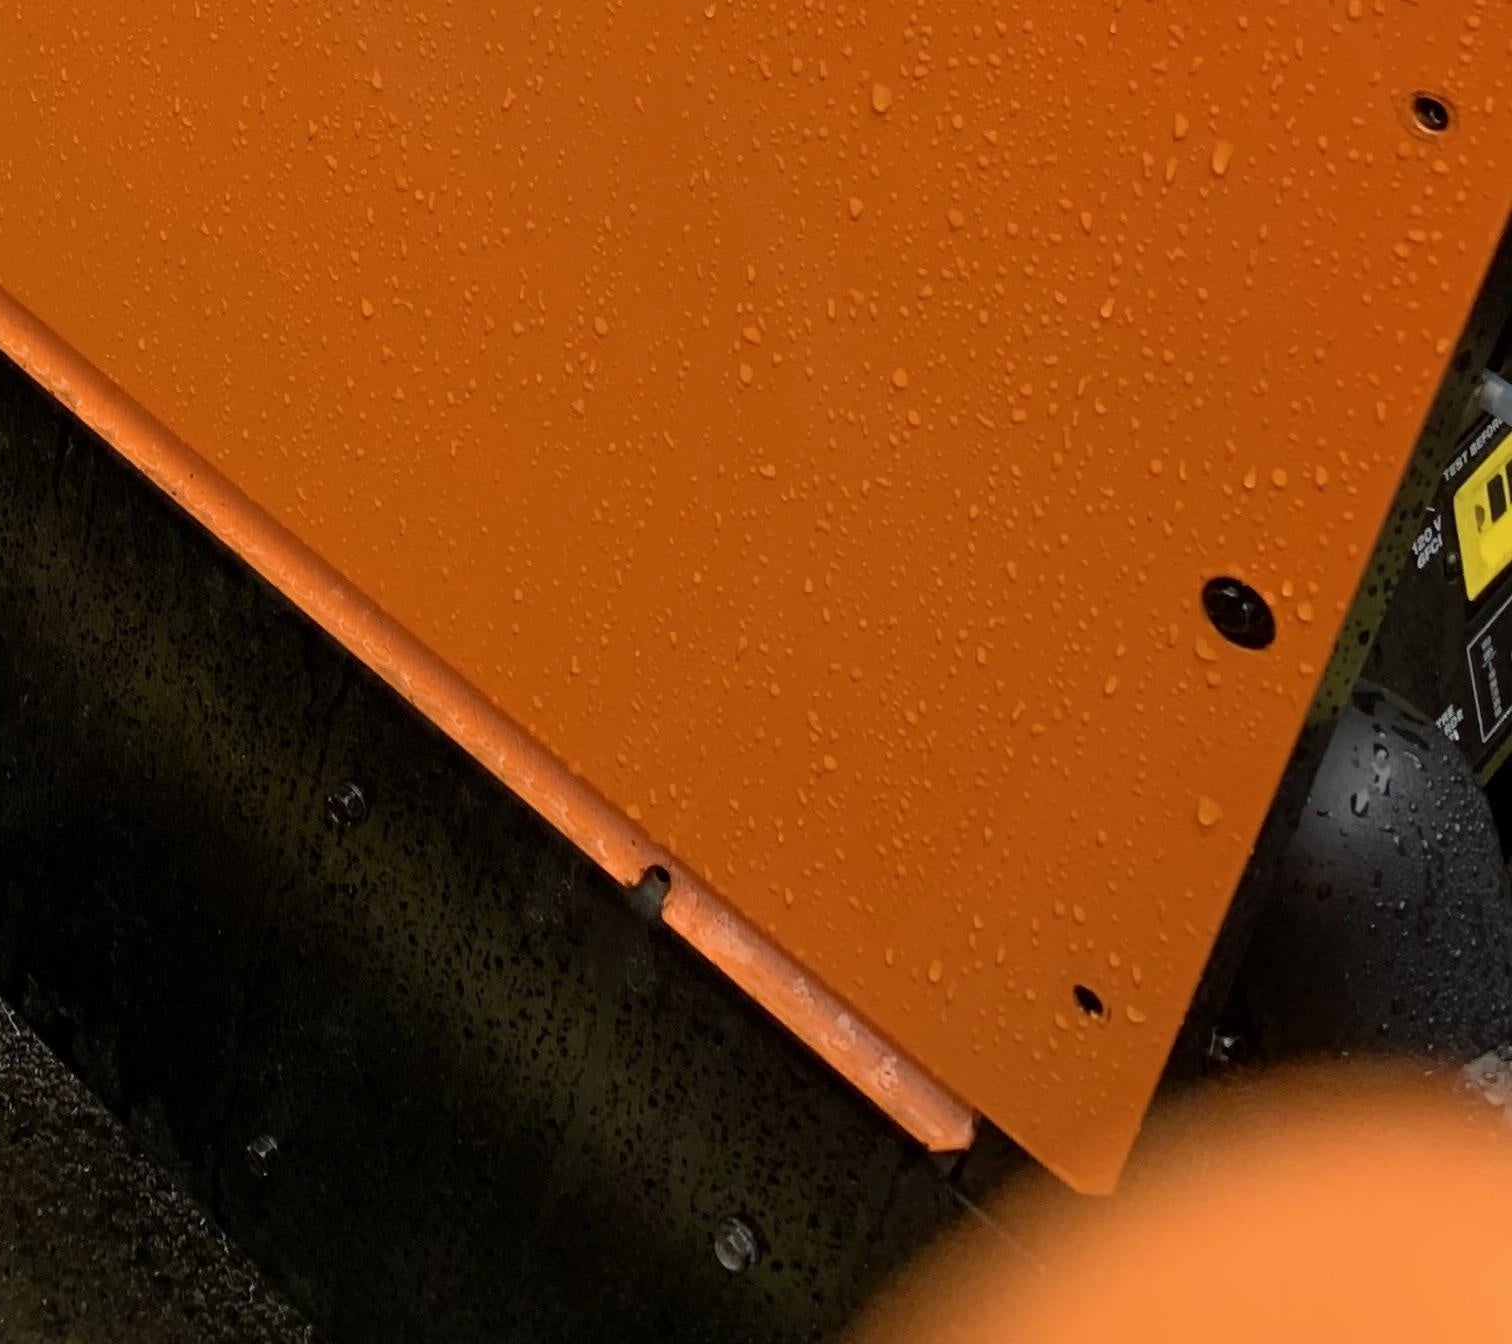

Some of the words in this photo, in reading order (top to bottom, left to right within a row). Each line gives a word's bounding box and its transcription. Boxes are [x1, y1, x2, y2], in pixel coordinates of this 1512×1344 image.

[1443, 451, 1469, 481] TEST
[1411, 527, 1433, 556] 120
[1433, 515, 1442, 532] V
[1416, 534, 1443, 569] GFCI
